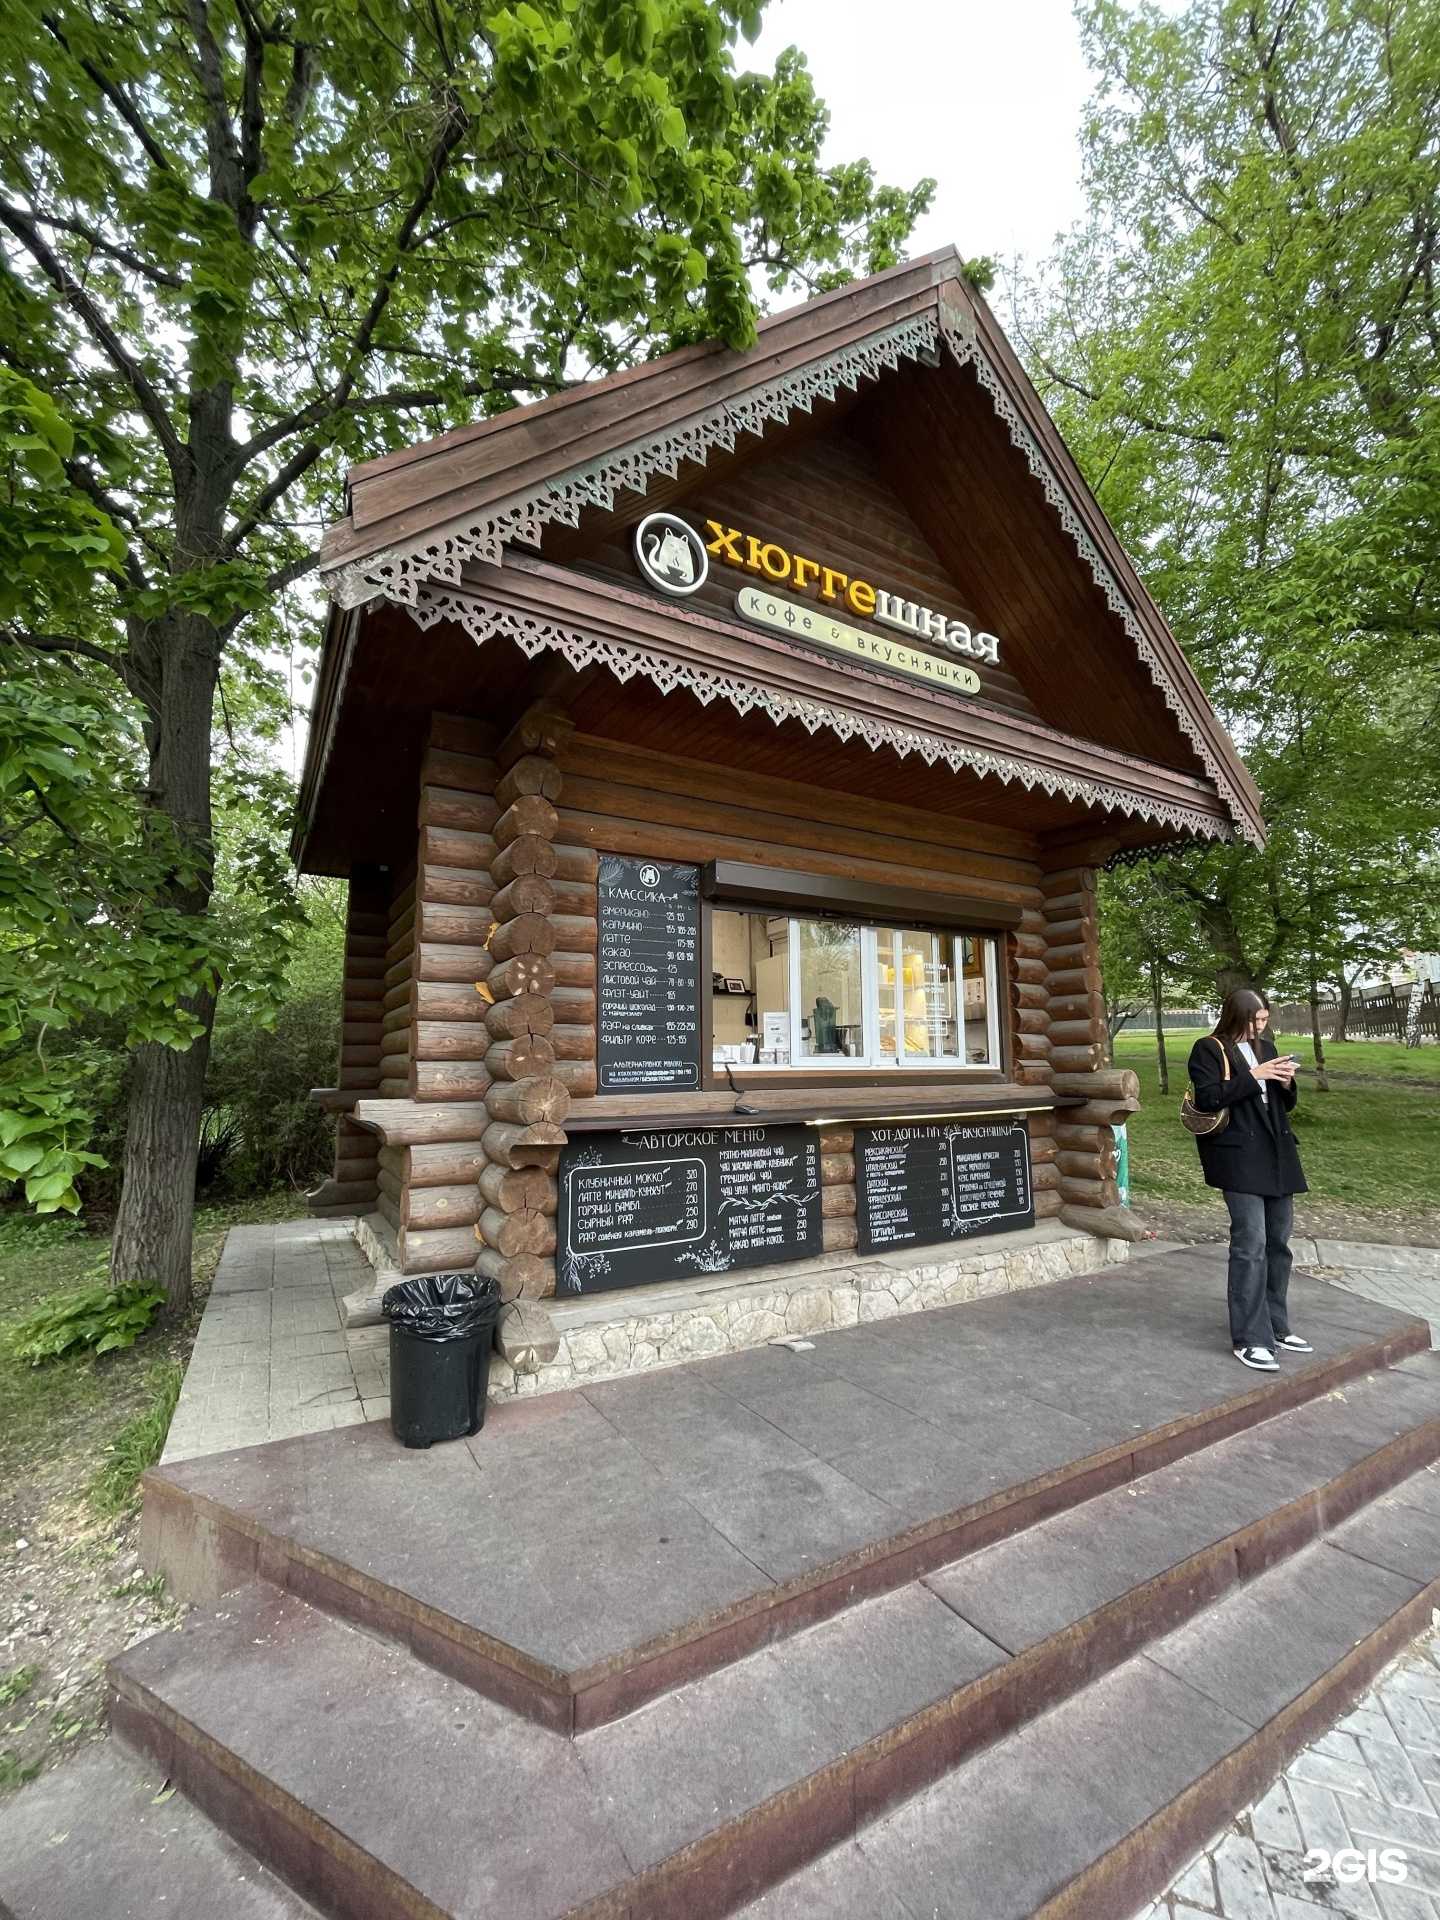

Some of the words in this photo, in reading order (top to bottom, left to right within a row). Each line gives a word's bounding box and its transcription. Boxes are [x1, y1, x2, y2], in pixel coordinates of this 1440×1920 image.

[705, 519, 1000, 665] хюггешная
[749, 595, 812, 628] кофе
[857, 636, 973, 687] вкусняшки
[609, 887, 666, 903] КЛАССИКА
[639, 1131, 719, 1149] АВТОРСКОЕ
[725, 1128, 765, 1144] МЕНЮ
[578, 1173, 632, 1190] КЛУБНИЧНЫЙ
[578, 1202, 612, 1217] ГОРЯЧИЙ
[577, 1215, 614, 1230] СЫРНЫЙ
